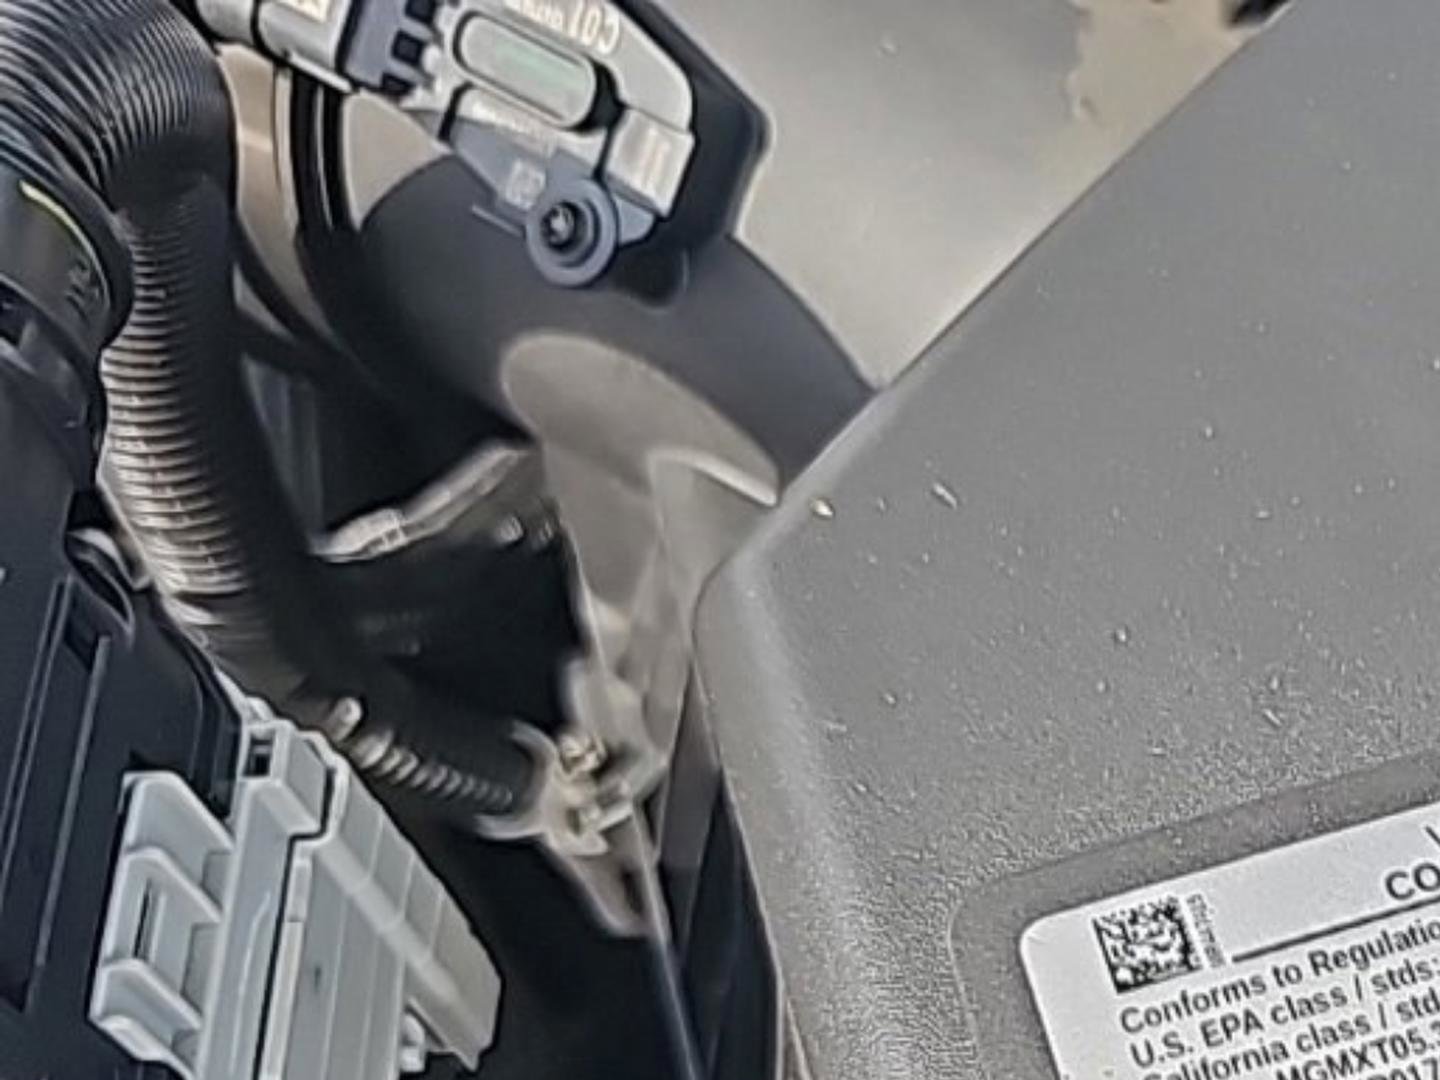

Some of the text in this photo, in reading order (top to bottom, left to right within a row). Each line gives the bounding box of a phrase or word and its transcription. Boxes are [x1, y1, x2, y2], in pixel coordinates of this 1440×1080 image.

[1119, 975, 1267, 1034] Conforms
[1272, 964, 1301, 987] to
[1130, 1031, 1194, 1068] U.S.
[1199, 1008, 1264, 1047] EPA
[1270, 986, 1347, 1025] class
[1295, 1014, 1372, 1053] class
